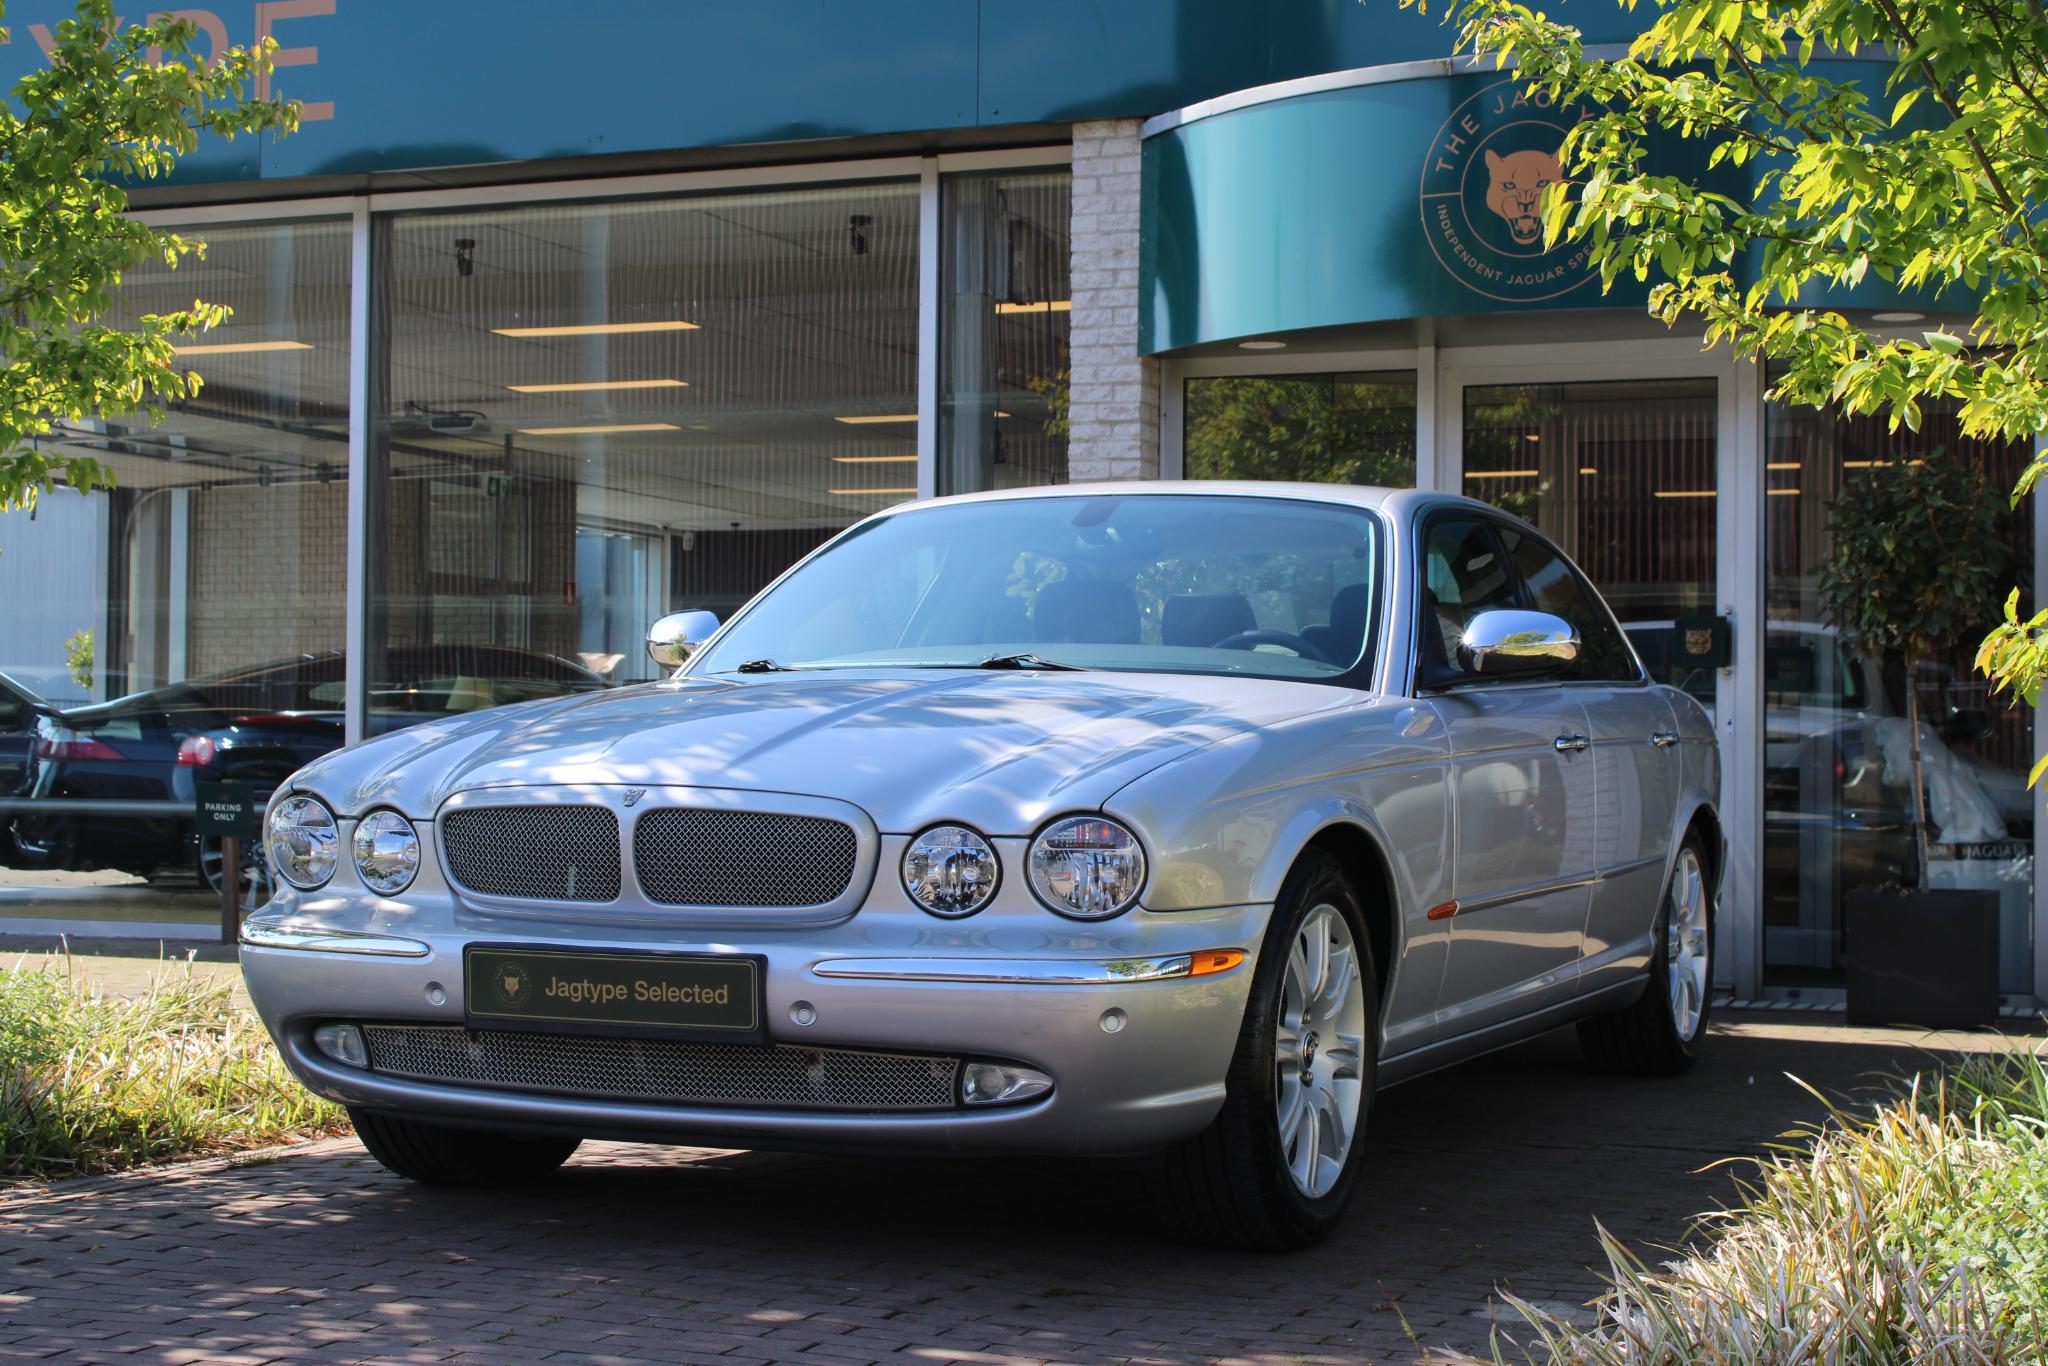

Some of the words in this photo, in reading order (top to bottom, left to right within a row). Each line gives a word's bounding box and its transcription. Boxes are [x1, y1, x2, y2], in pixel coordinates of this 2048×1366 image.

[1435, 114, 1481, 173] THE
[1437, 204, 1502, 281] INDEPENDENT
[1506, 265, 1565, 285] JAGUAR
[205, 803, 242, 812] PARKING
[213, 813, 236, 821] ONLY
[545, 977, 628, 1003] Jagtype
[634, 980, 728, 1005] Selected
